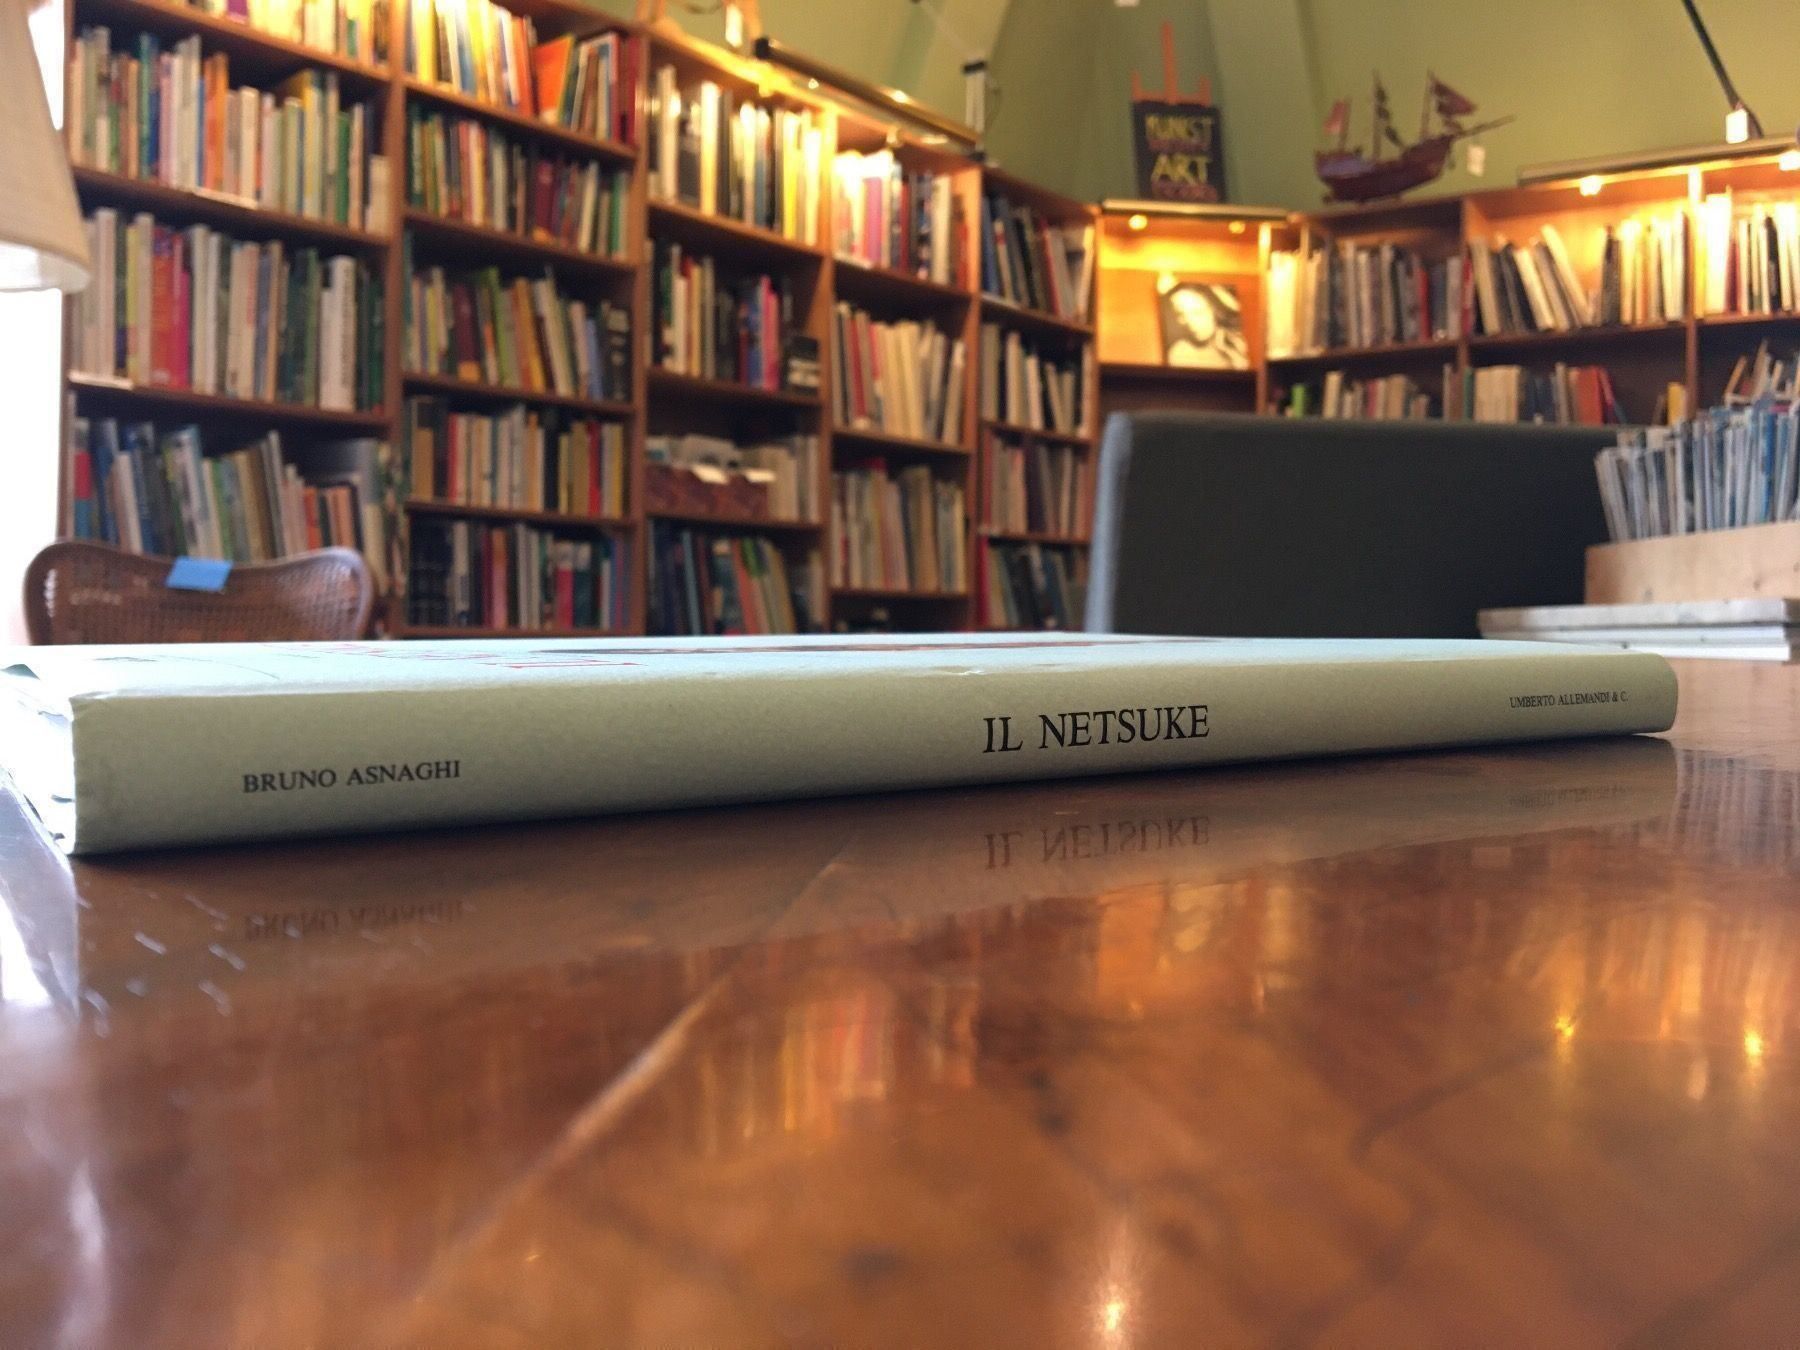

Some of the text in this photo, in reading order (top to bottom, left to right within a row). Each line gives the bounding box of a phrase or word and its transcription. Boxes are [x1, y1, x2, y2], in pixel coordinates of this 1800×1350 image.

[1150, 153, 1210, 185] ART
[1509, 691, 1628, 708] UMBERTO ALLEMANDI & C.
[982, 705, 1210, 753] IL NETSUKE
[242, 760, 461, 793] BRUNO ASNAGHI
